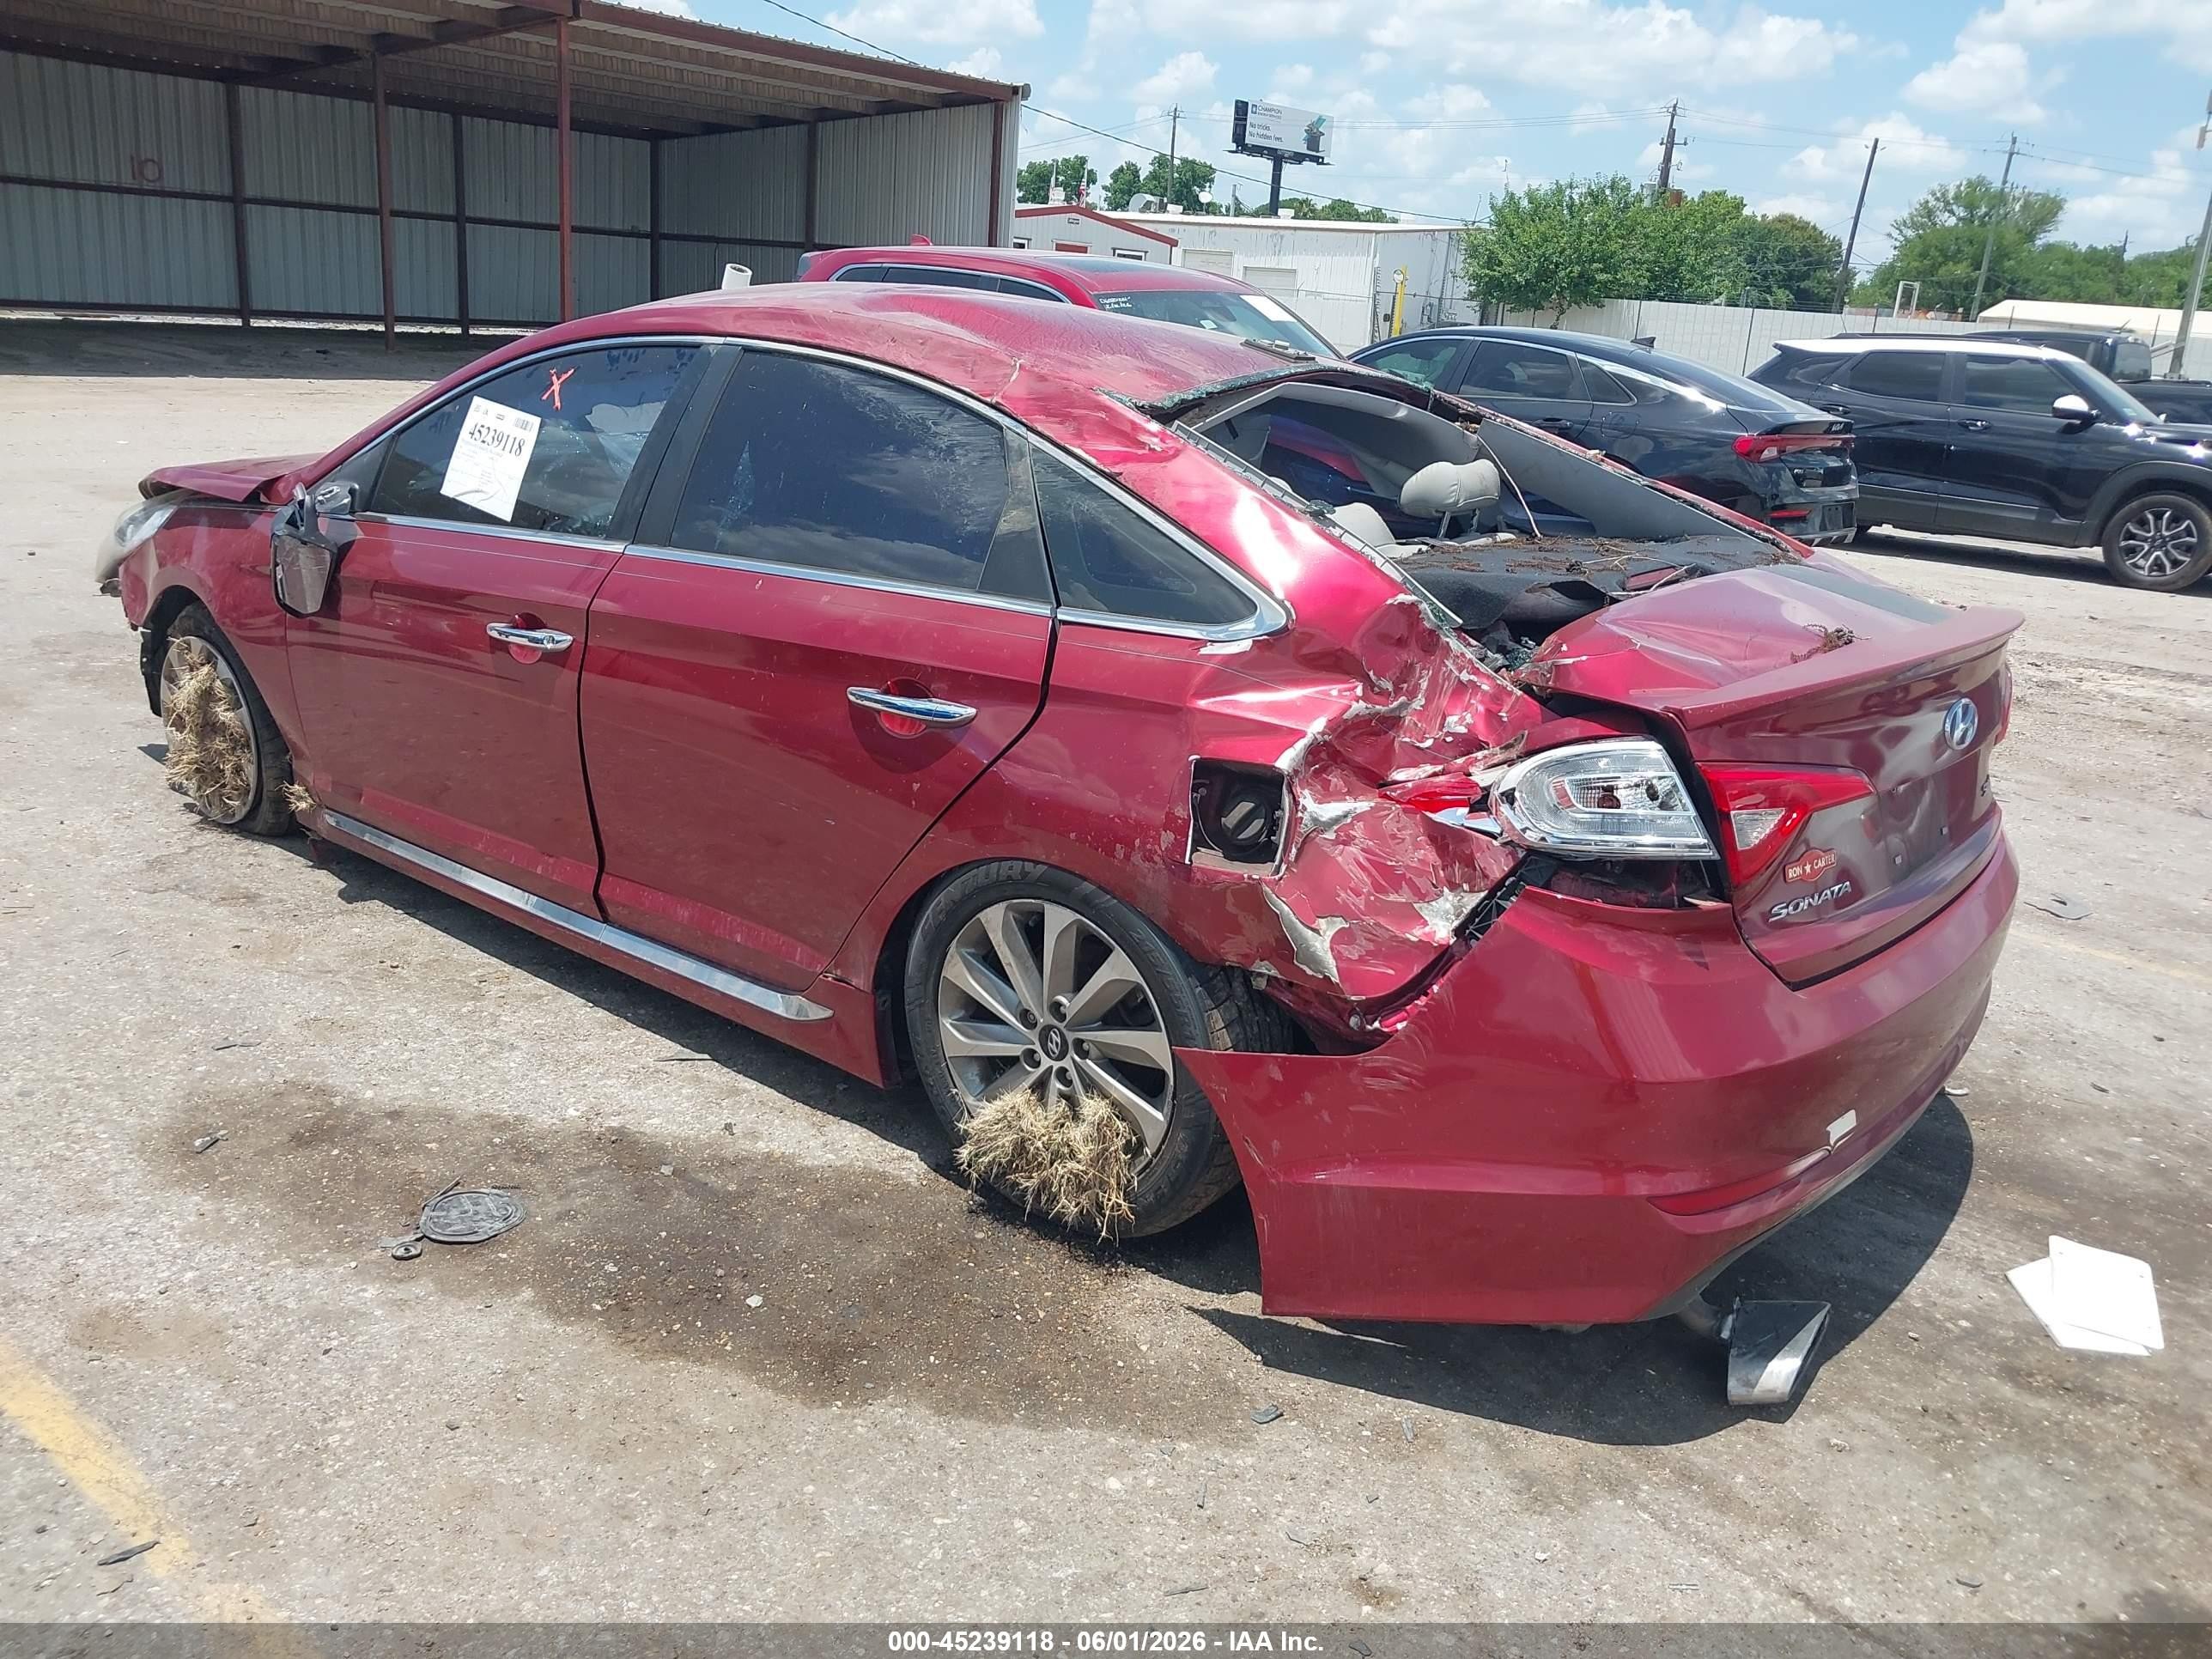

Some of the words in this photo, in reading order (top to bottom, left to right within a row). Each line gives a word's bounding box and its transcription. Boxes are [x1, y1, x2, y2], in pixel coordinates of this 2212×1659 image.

[1258, 105, 1282, 114] CHAMPION
[469, 422, 525, 456] 45239118
[1788, 866, 1802, 878] RON
[1813, 854, 1835, 869] CARTER
[1768, 881, 1852, 922] SONATA
